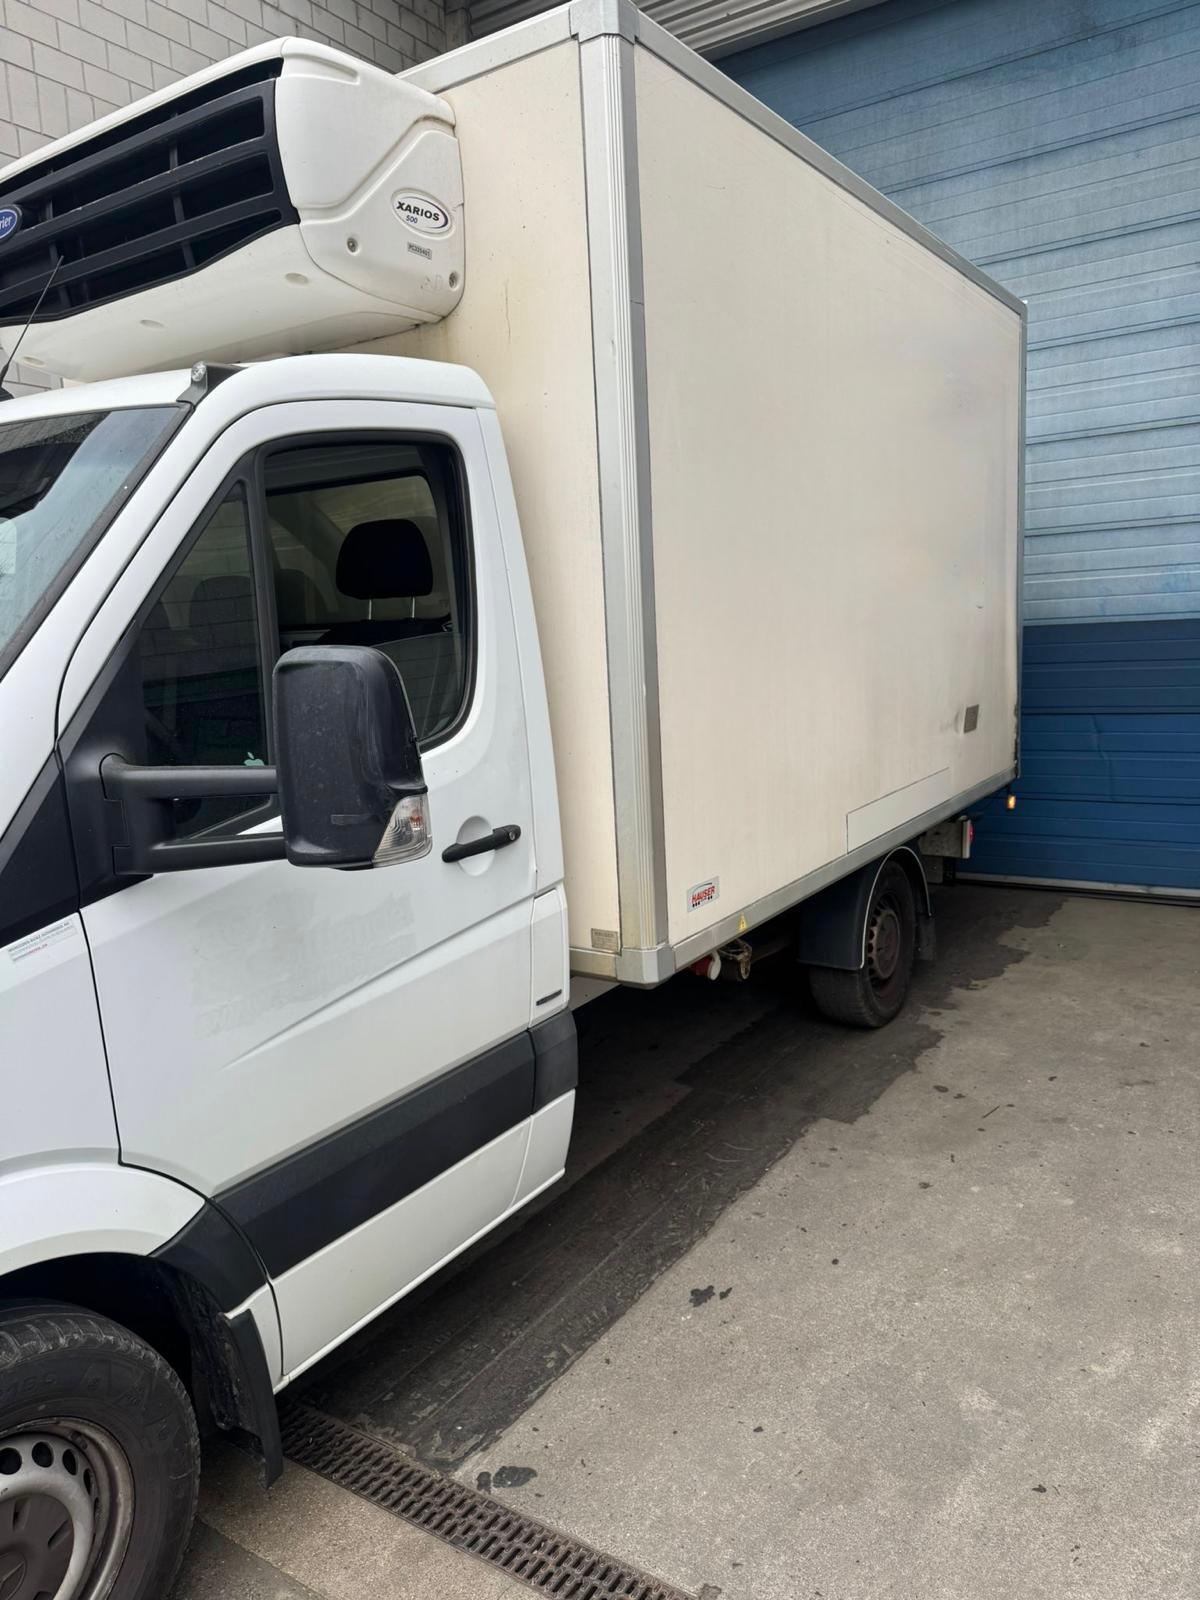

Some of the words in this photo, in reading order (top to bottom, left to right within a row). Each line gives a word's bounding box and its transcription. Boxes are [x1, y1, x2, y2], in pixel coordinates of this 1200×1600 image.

[396, 200, 440, 222] XARIOS
[405, 214, 418, 224] 500
[691, 885, 715, 904] HAUSER
